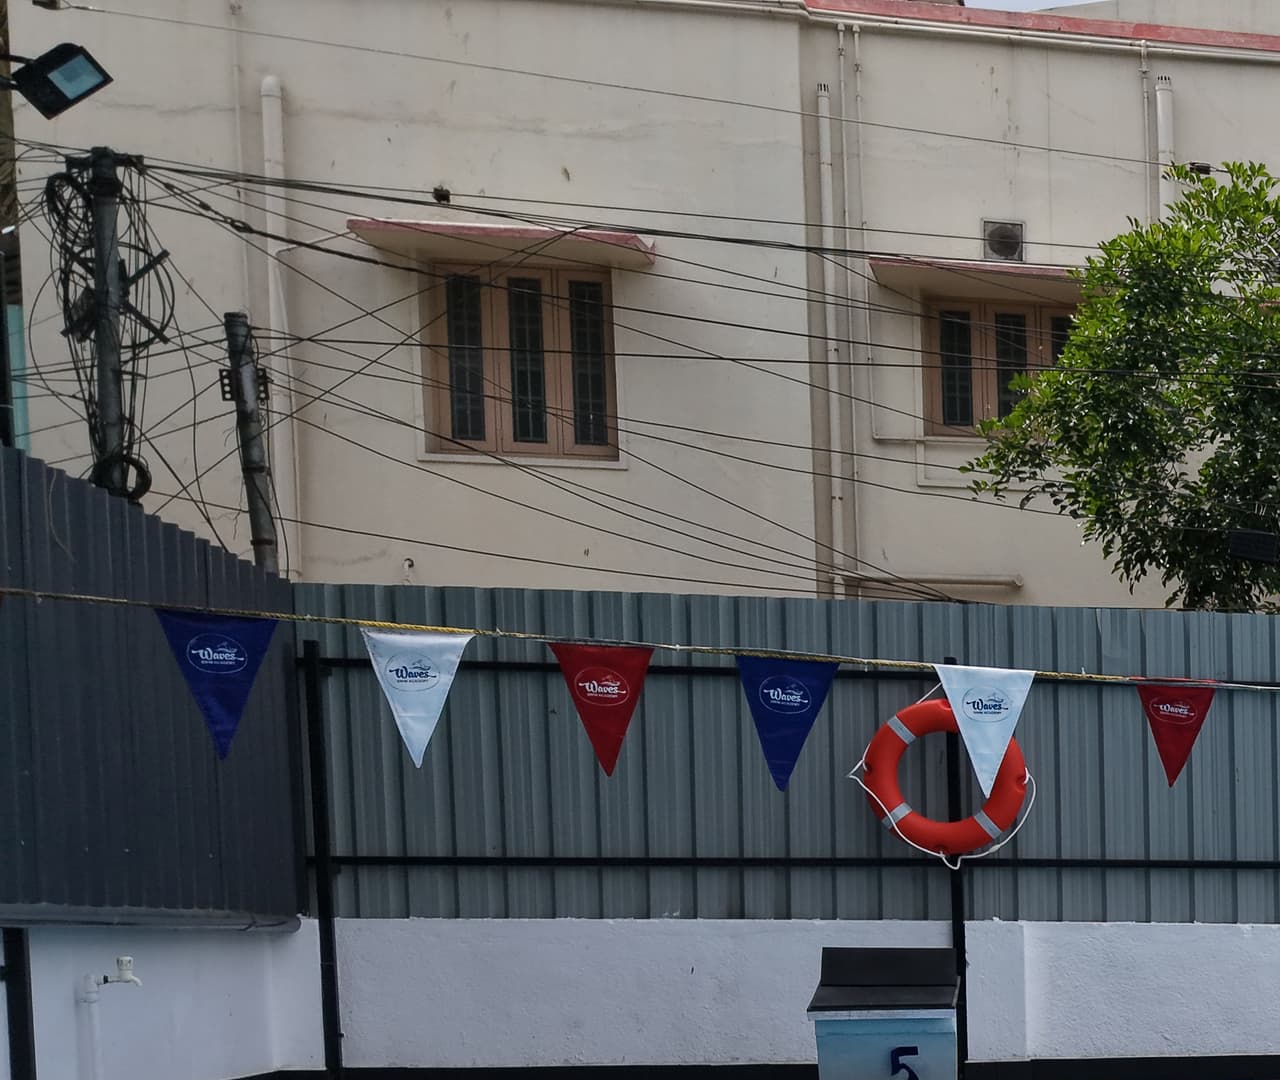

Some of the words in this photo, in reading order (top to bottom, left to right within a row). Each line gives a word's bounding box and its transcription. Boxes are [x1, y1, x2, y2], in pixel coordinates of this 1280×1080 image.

[192, 647, 244, 661] Waves
[389, 665, 437, 679] Waves
[579, 680, 626, 694] Waves
[763, 687, 808, 703] Waves
[966, 698, 1008, 711] Waves
[1153, 703, 1194, 716] Waves
